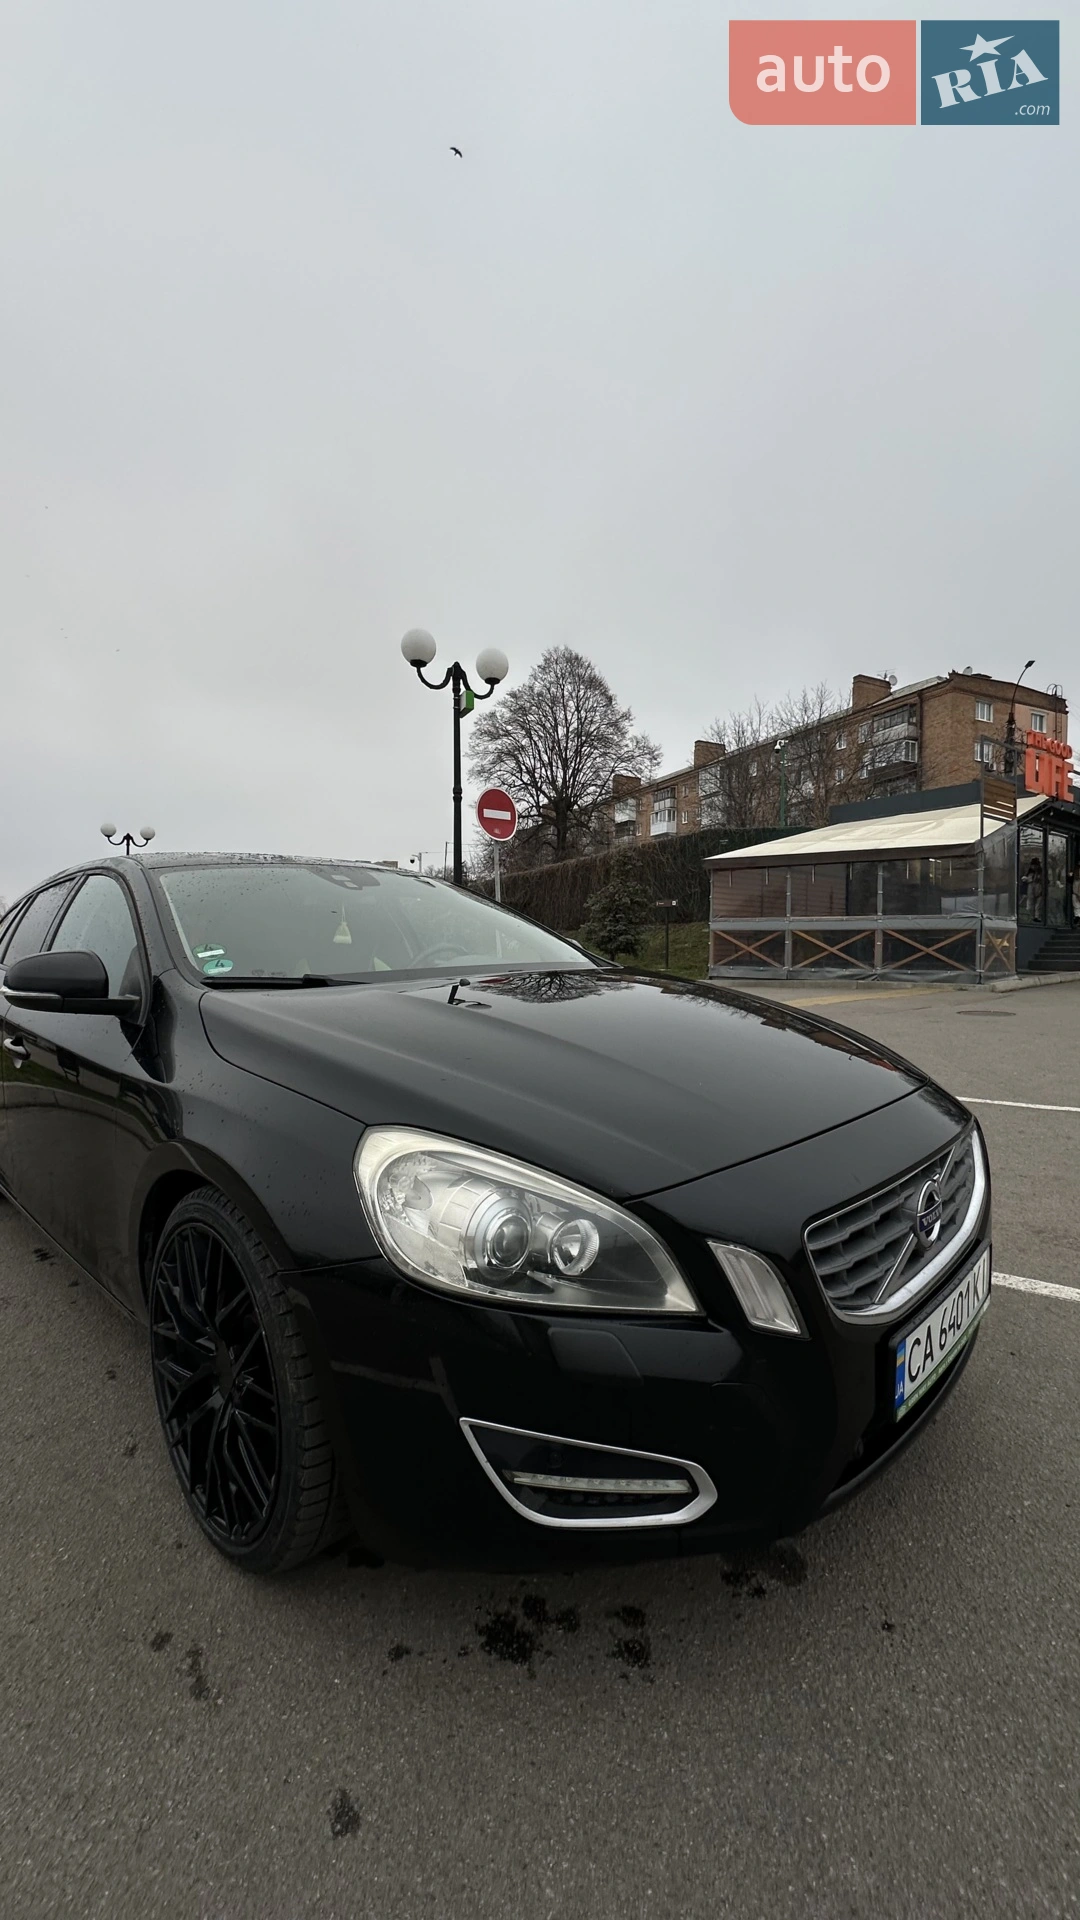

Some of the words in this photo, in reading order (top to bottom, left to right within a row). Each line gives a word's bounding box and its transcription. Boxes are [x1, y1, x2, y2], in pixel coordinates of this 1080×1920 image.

[1025, 748, 1074, 803] LIFE
[1046, 738, 1073, 759] GOOD
[908, 1325, 934, 1383] CA
[939, 1281, 970, 1351] 6401
